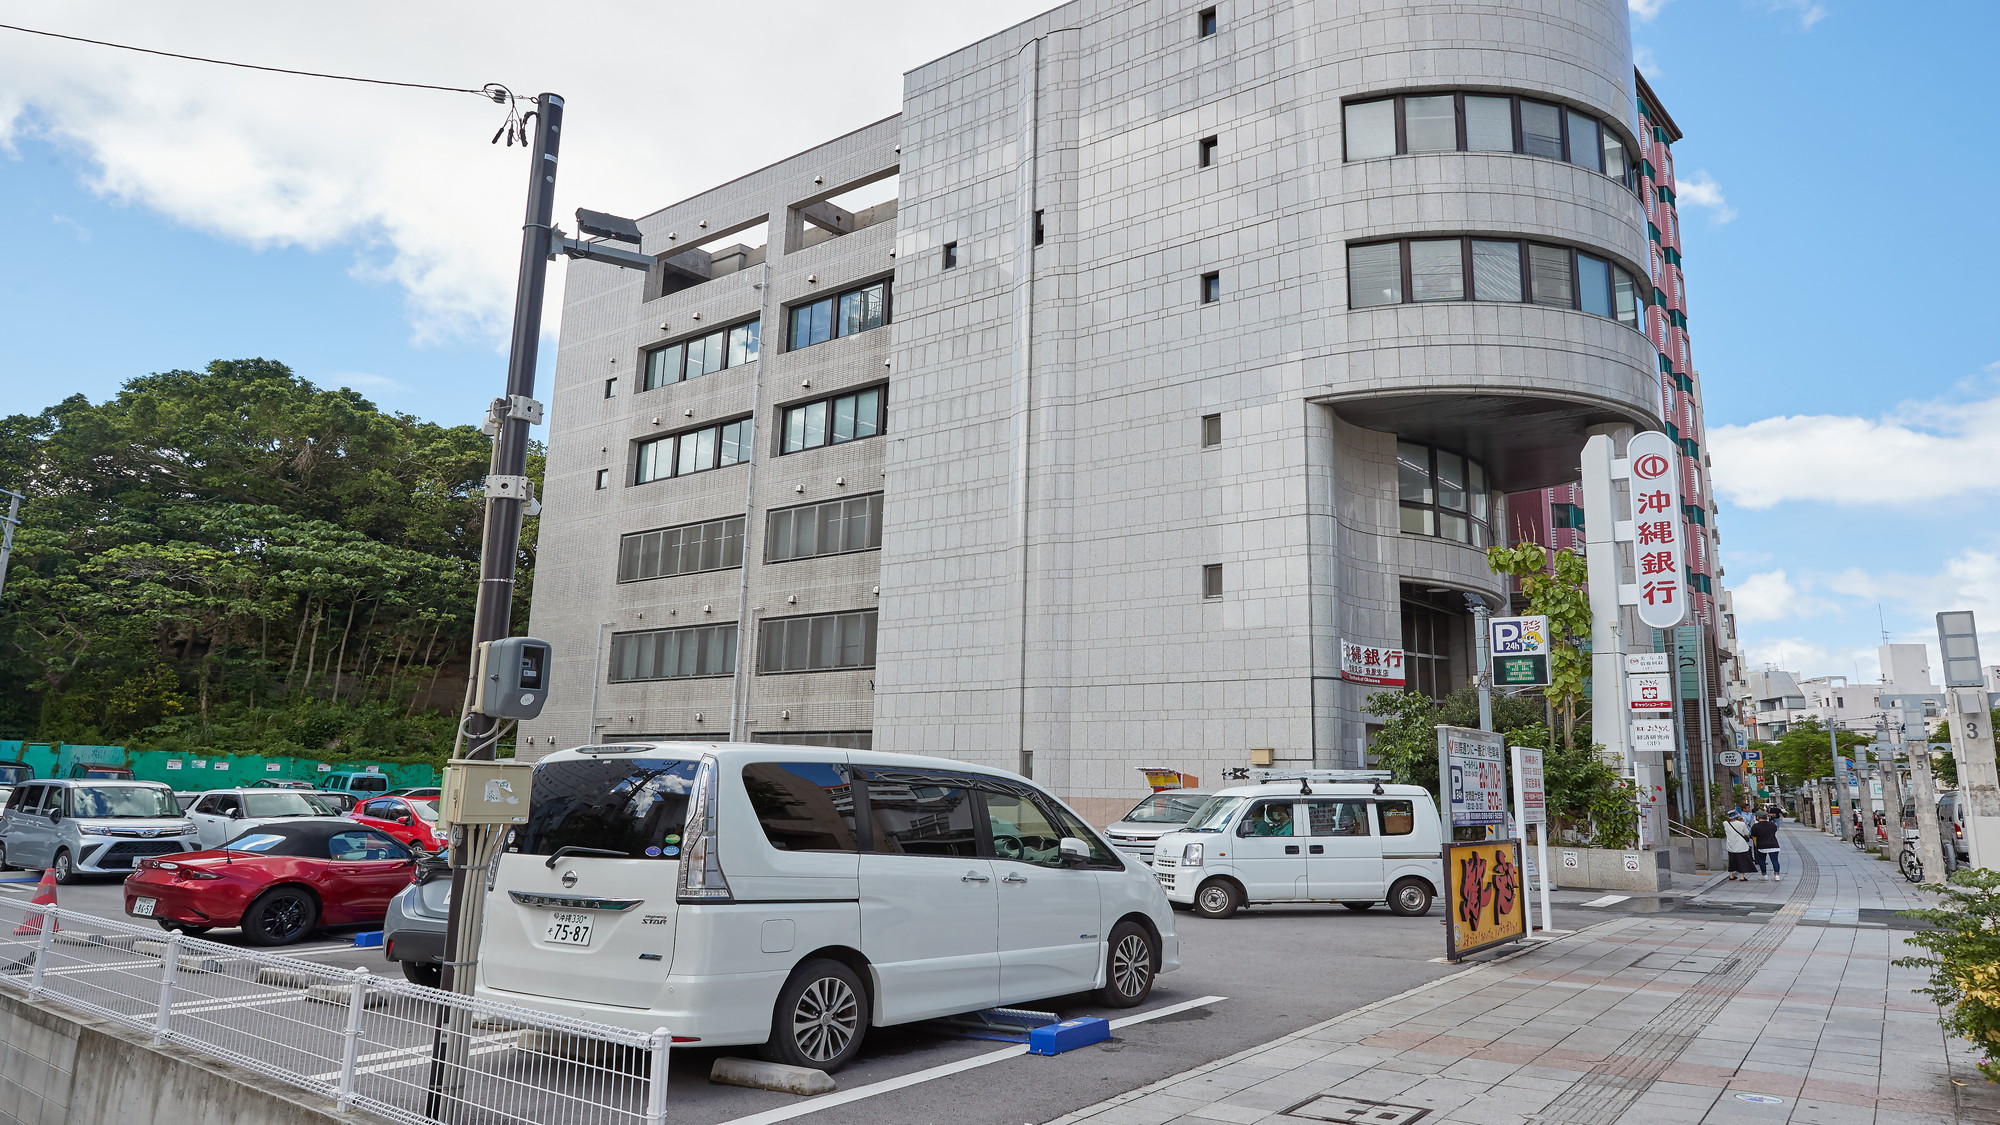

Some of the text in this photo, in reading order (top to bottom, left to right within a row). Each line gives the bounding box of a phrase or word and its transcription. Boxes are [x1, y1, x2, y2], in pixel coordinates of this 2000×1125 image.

[1637, 490, 1677, 605] 沖縄銀行
[1495, 624, 1519, 651] P
[1505, 642, 1520, 651] 24h
[1647, 724, 1670, 733] おきぎん
[1966, 722, 1979, 739] 3
[1745, 752, 1758, 760] P
[1916, 760, 1924, 771] 5
[1885, 774, 1891, 782] 6
[1452, 769, 1462, 800] P
[559, 914, 584, 923] 沖縄330
[554, 923, 590, 943] 75-87
